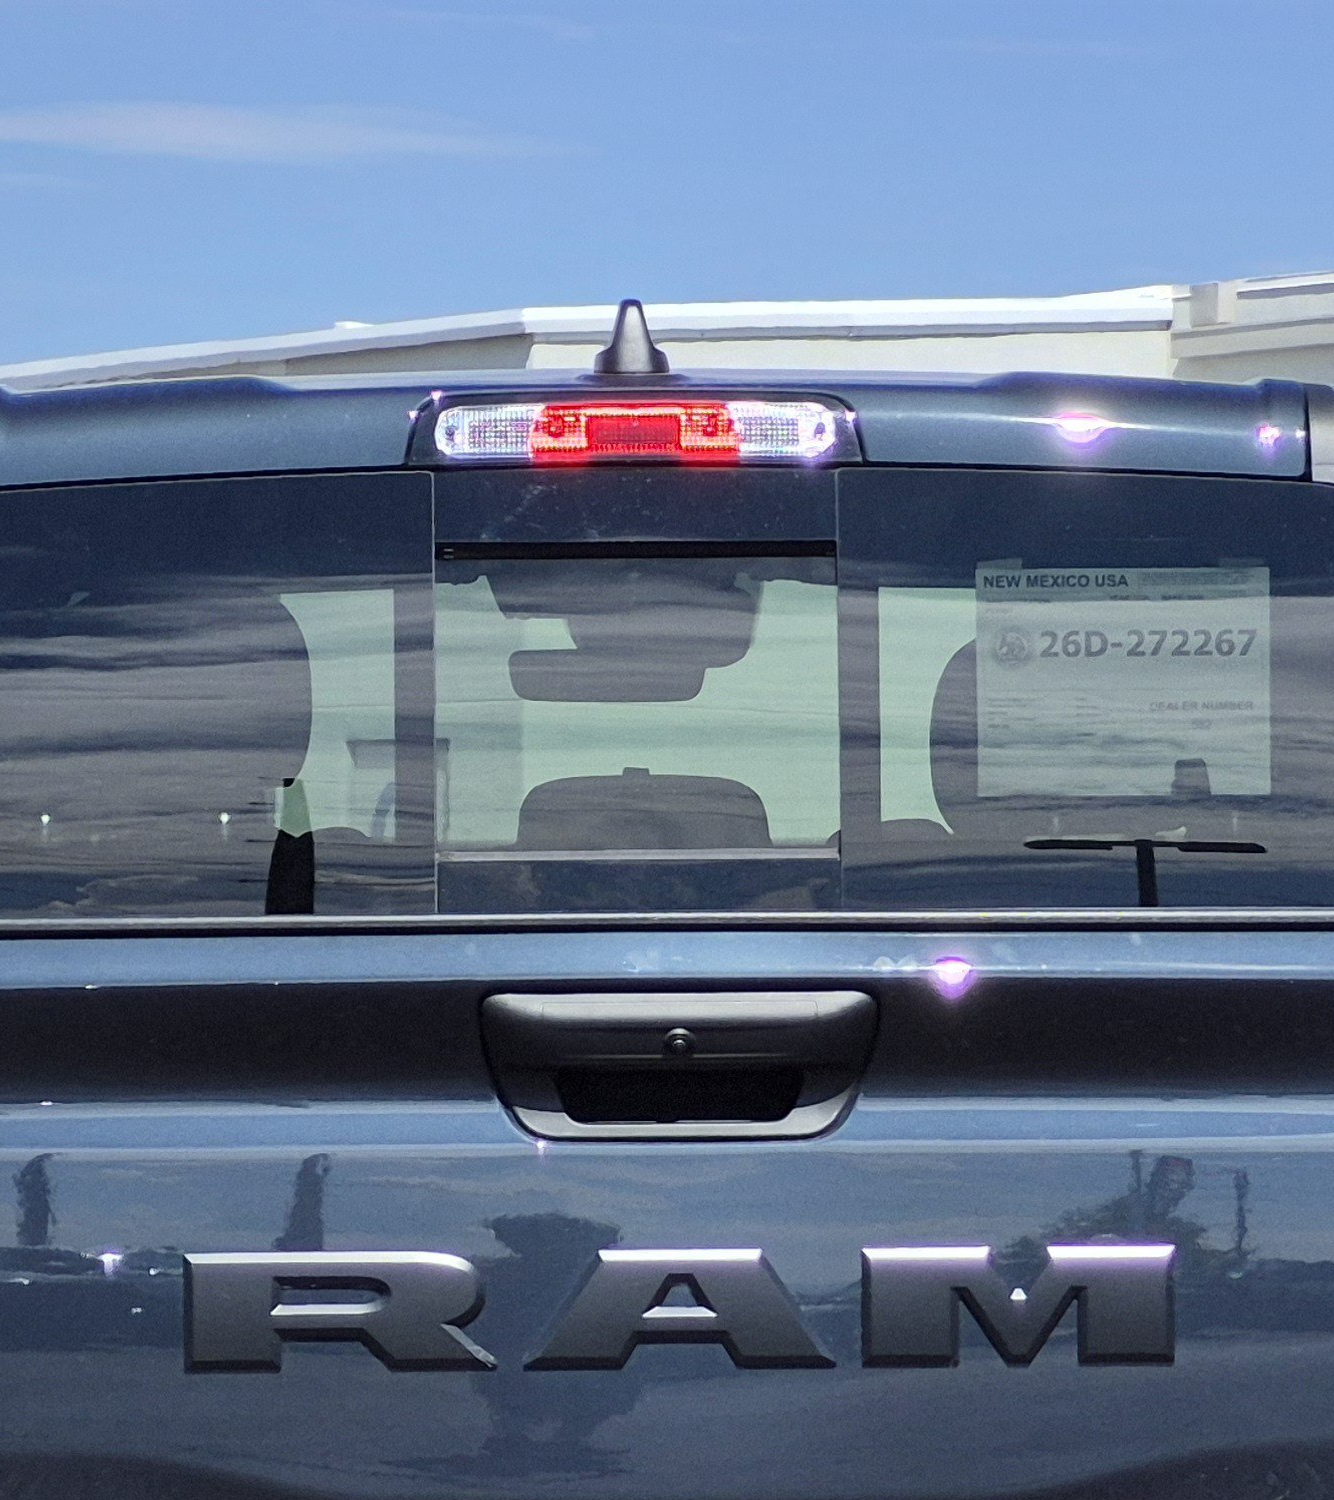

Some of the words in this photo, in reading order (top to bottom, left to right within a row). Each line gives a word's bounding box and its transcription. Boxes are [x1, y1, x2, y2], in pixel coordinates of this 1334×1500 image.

[983, 574, 1021, 588] NEW
[1026, 574, 1090, 588] MEXICO
[1095, 574, 1129, 588] USA
[1040, 629, 1258, 658] 26D-272267
[183, 1243, 1177, 1374] RAM
